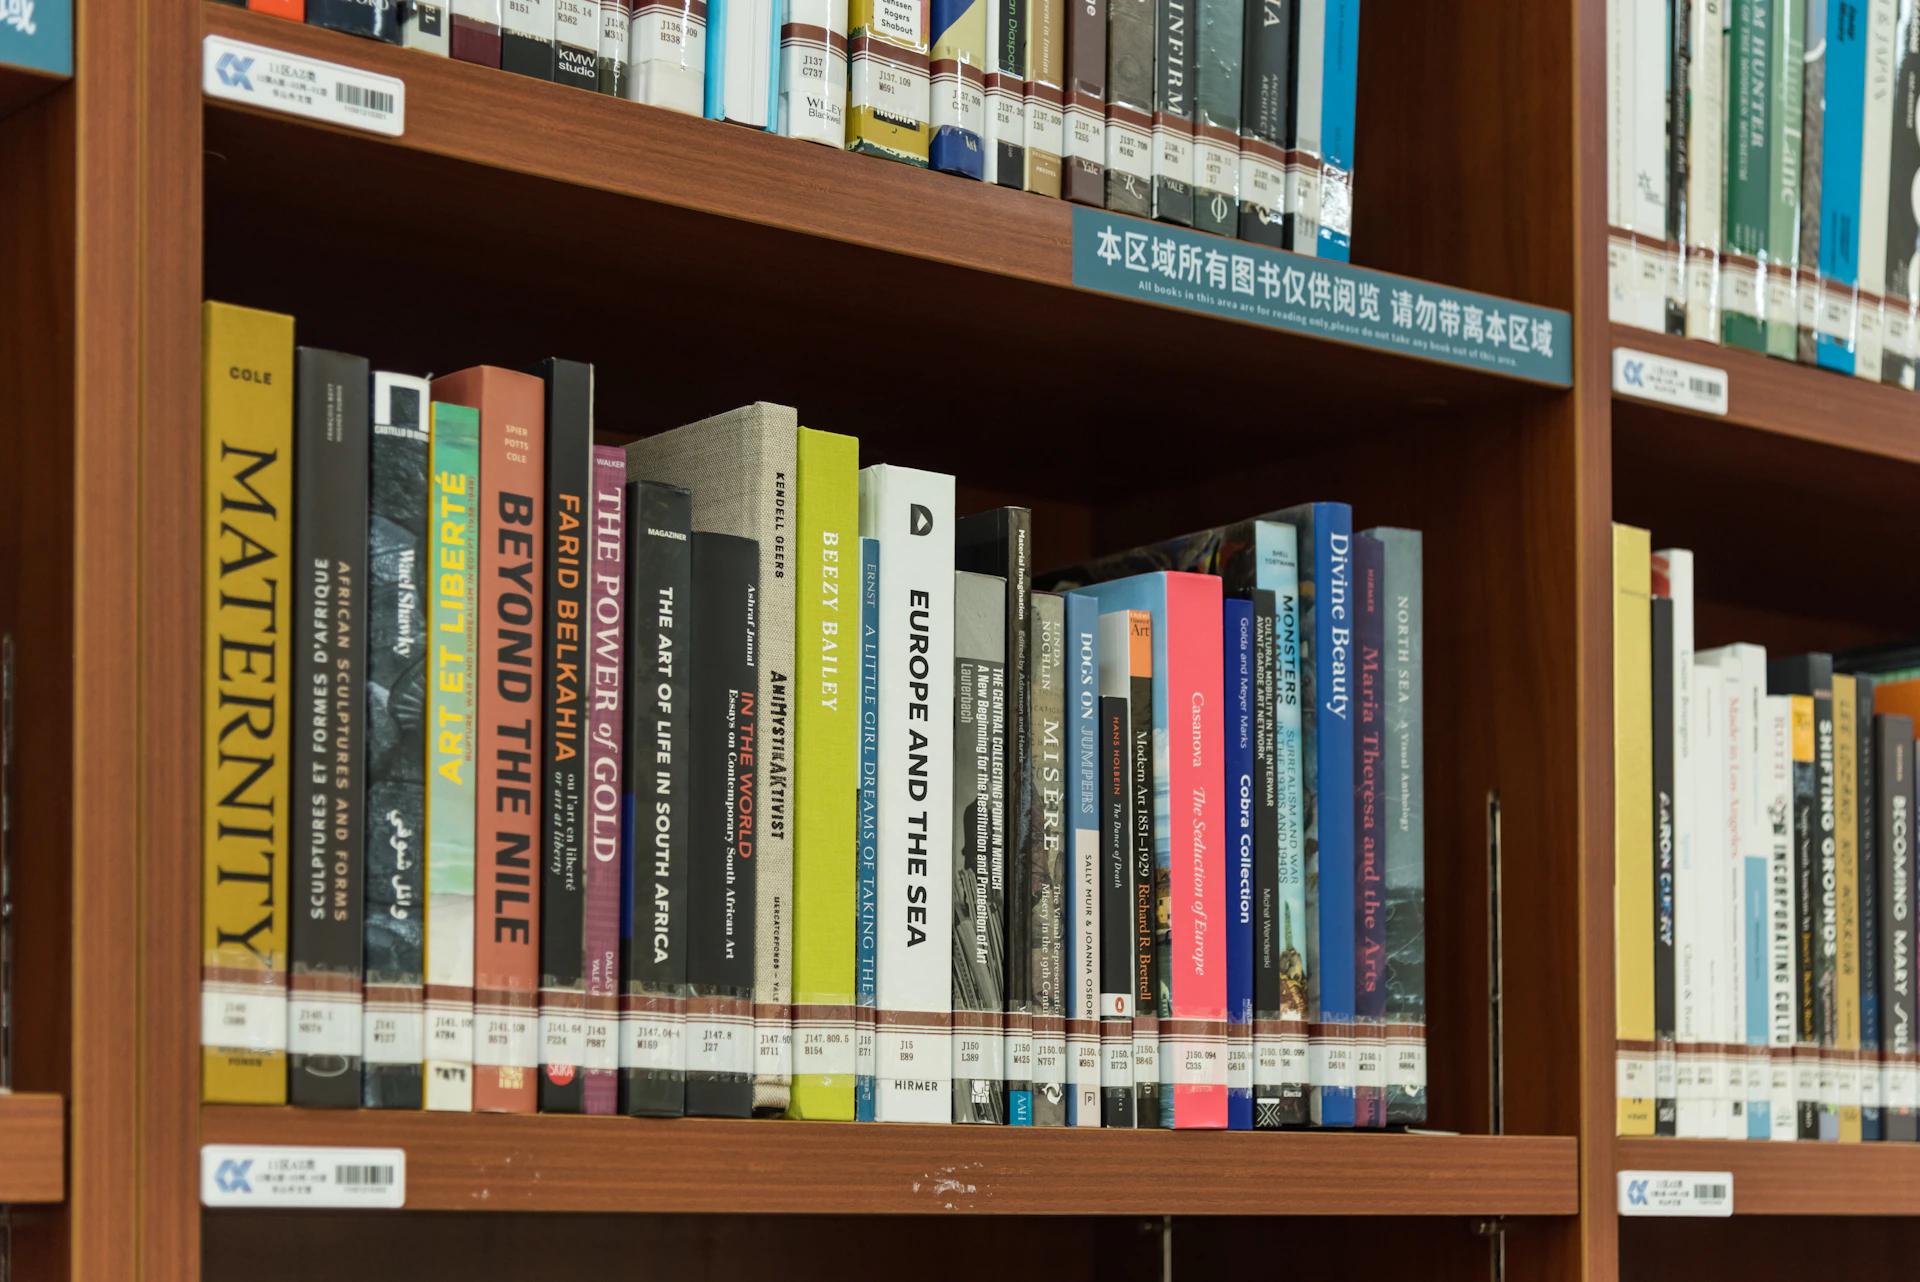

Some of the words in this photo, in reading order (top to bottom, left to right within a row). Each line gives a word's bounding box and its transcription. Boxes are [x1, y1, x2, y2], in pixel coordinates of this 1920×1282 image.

[557, 14, 578, 27] R362
[881, 18, 914, 36] Shabout
[884, 8, 911, 23] Rogers
[558, 61, 595, 79] studio
[559, 49, 596, 68] KMW
[802, 67, 823, 79] C737
[803, 55, 823, 67] J137
[879, 70, 911, 88] J137.109
[1751, 37, 1765, 148] HUNTER
[1082, 160, 1098, 175] Yale
[1167, 180, 1184, 193] YALE
[1097, 230, 1381, 322] 本区域所有图书仅供阅览
[1390, 289, 1554, 359] 请勿带离本区域
[1138, 280, 1151, 293] All
[1154, 283, 1182, 299] books
[1185, 288, 1195, 301] in
[1196, 291, 1214, 305] this
[1217, 297, 1237, 311] area
[1240, 300, 1256, 313] are
[1257, 303, 1271, 316] for
[1272, 306, 1307, 326] reading
[1361, 326, 1373, 337] do
[1375, 328, 1389, 341] not
[1391, 330, 1410, 345] take
[1412, 337, 1428, 352] any
[1430, 338, 1450, 354] book
[1452, 343, 1467, 357] out
[1468, 344, 1478, 358] of
[1480, 347, 1496, 362] this
[229, 366, 272, 385] COLE
[557, 493, 580, 590] FARID
[597, 487, 621, 563] THE
[435, 471, 466, 633] LIBERTÉ
[1018, 529, 1026, 566] Material
[822, 531, 839, 612] BEEZY
[1331, 532, 1349, 620] Divine
[337, 561, 350, 648] AFRICAN
[497, 490, 534, 703] BEYOND
[658, 587, 673, 628] THE
[1017, 568, 1026, 620] Imagination
[595, 573, 621, 711] POWER
[865, 624, 876, 637] A
[1240, 617, 1249, 650] Golda
[1265, 617, 1273, 668] CULTURAL
[1283, 595, 1296, 706] MONSTERS
[439, 645, 464, 694] ET
[657, 633, 672, 677] ART
[821, 620, 838, 712] BAILEY
[864, 643, 877, 705] LITTLE
[908, 589, 930, 722] EUROPE
[992, 668, 1004, 685] THE
[1240, 653, 1248, 674] and
[1327, 626, 1350, 720] Beauty
[555, 600, 579, 762] BELKAHIA
[657, 683, 672, 714] OF
[977, 674, 989, 698] New
[1239, 677, 1249, 712] Meyer
[1265, 671, 1273, 717] MOBILITY
[1363, 645, 1378, 723] Maria
[217, 440, 278, 969] MATERNITY
[336, 658, 350, 789] SCULPTURES
[726, 689, 739, 728] Essays
[741, 691, 754, 716] IN
[992, 687, 1004, 734] CENTRAL
[1265, 720, 1273, 728] IN
[438, 705, 463, 786] ART
[593, 722, 618, 752] of
[656, 721, 672, 765] LIFE
[728, 732, 735, 749] on
[739, 722, 754, 766] THE
[864, 711, 876, 755] GIRL
[976, 700, 989, 754] Beginning
[1191, 692, 1205, 768] Casanova
[1240, 716, 1249, 749] Marks
[496, 719, 531, 815] THE
[656, 772, 671, 795] IN
[908, 729, 928, 802] AND
[977, 756, 989, 771] for
[977, 773, 989, 790] the
[992, 737, 1004, 799] COLLECTING
[1266, 754, 1274, 806] INTERWAR
[1363, 732, 1379, 829] Theresa
[1820, 720, 1834, 832] SHIFTING
[335, 798, 348, 841] AND
[592, 756, 618, 863] GOLD
[725, 752, 737, 845] Contemporary
[738, 774, 753, 859] WORLD
[863, 764, 876, 840] DREAMS
[992, 801, 1004, 831] POINT
[1193, 786, 1206, 816] The
[1240, 774, 1251, 828] Cobra
[387, 809, 413, 870] شوقي
[655, 801, 671, 878] SOUTH
[907, 811, 927, 876] THE
[977, 792, 989, 852] Restitution
[992, 834, 1003, 844] IN
[1659, 791, 1672, 869] AARON
[726, 847, 735, 884] South
[863, 848, 876, 871] OF
[977, 854, 988, 874] and
[991, 847, 1003, 890] MUNICH
[1193, 818, 1207, 903] Seduction
[1240, 833, 1250, 924] Collection
[1364, 836, 1380, 881] and
[1893, 795, 1907, 921] BECOMING
[334, 851, 347, 921] FORMS
[391, 875, 411, 919] وائل
[494, 831, 531, 946] NILE
[976, 876, 988, 932] Protection
[1822, 837, 1836, 957] GROUNDS
[653, 883, 669, 964] AFRICA
[726, 886, 736, 936] African
[862, 877, 875, 949] TAKING
[907, 884, 927, 948] SEA
[1191, 900, 1207, 920] of
[1364, 890, 1380, 929] the
[1660, 872, 1673, 947] CURRY
[725, 940, 735, 960] Art
[976, 934, 988, 946] of
[976, 947, 988, 964] Art
[1192, 922, 1207, 976] Europe
[862, 955, 875, 993] THE
[1365, 936, 1380, 992] Arts
[1894, 930, 1908, 996] MARY
[586, 1025, 606, 1037] J143
[703, 1031, 732, 1042] J147.8
[703, 1042, 718, 1053] J27
[760, 1046, 779, 1057] H711
[804, 1045, 823, 1056] B154
[805, 1033, 849, 1044] J147.809.5
[858, 1047, 871, 1057] E71
[859, 1035, 872, 1046] J15
[900, 1040, 913, 1051] J15
[961, 1041, 980, 1052] J150
[1014, 1044, 1030, 1054] J150
[900, 1051, 913, 1062] E89
[961, 1052, 979, 1063] L389
[1037, 1056, 1055, 1066] N757
[1186, 1051, 1217, 1061] J150.094
[1186, 1062, 1202, 1071] C335
[894, 1079, 938, 1092] HIRMER
